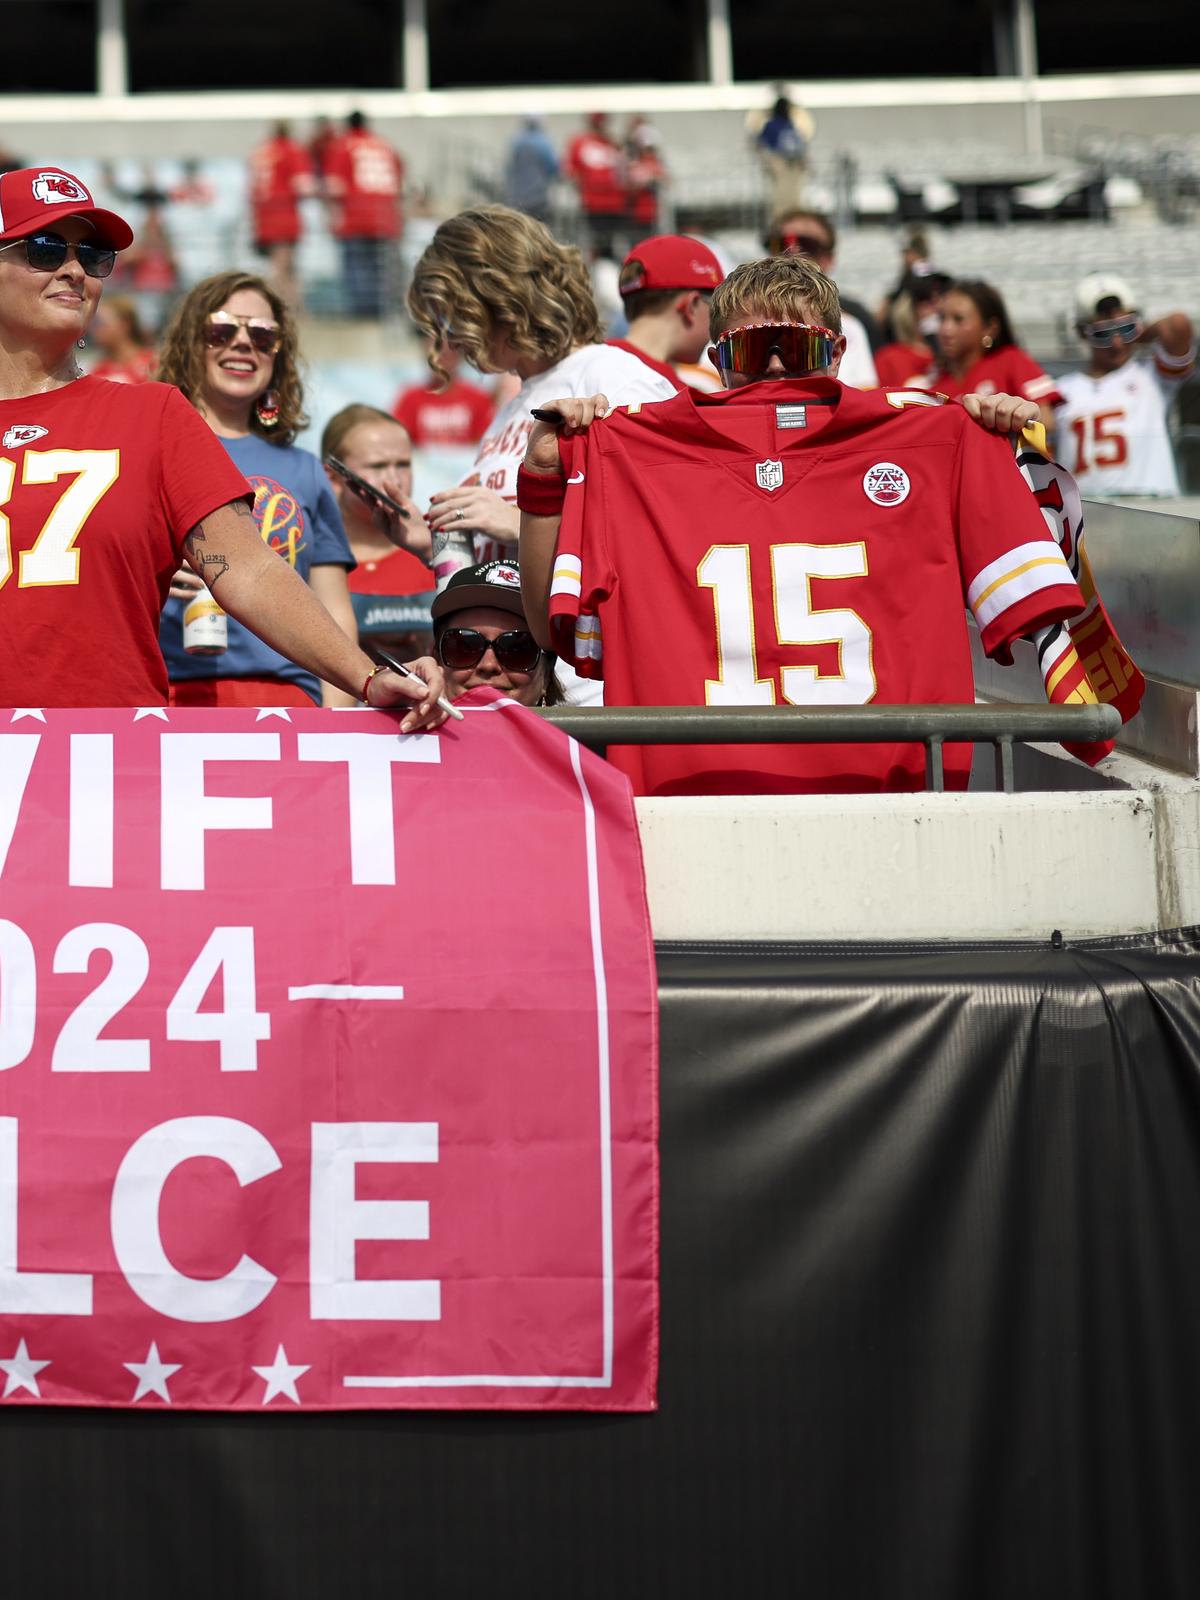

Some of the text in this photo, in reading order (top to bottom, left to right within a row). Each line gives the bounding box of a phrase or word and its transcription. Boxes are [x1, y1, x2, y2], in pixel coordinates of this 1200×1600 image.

[1070, 408, 1128, 475] 15
[761, 472, 779, 486] NFL
[475, 559, 501, 577] SUPER
[696, 541, 878, 706] 15
